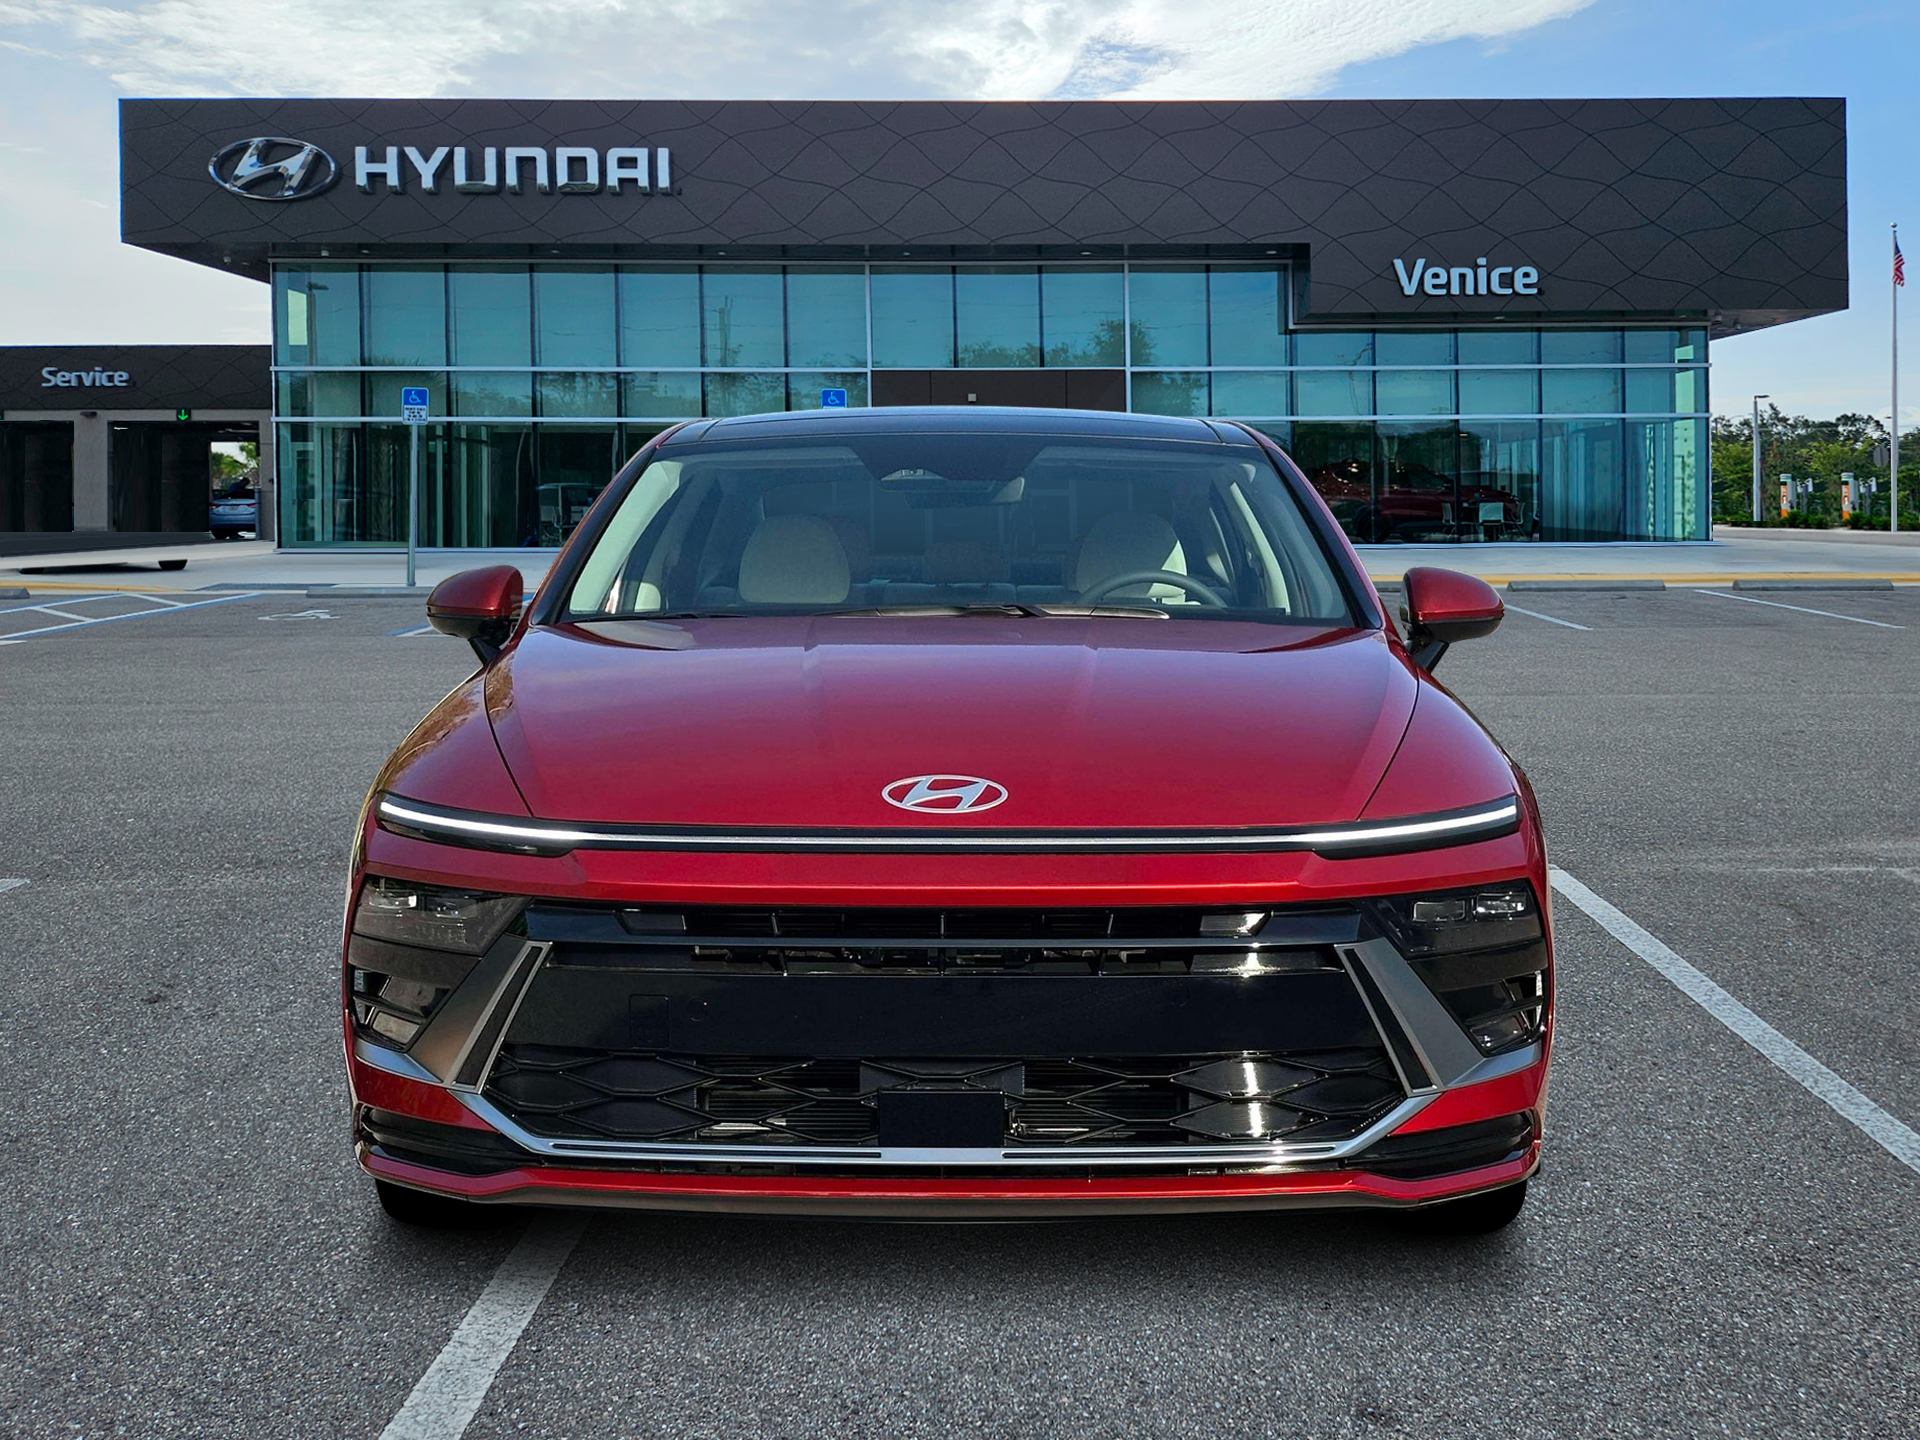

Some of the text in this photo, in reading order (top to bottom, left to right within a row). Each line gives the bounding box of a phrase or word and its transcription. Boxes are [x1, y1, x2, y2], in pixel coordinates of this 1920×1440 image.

[355, 146, 671, 194] HYUNDAI
[1393, 257, 1539, 296] Venice
[41, 366, 130, 387] Service
